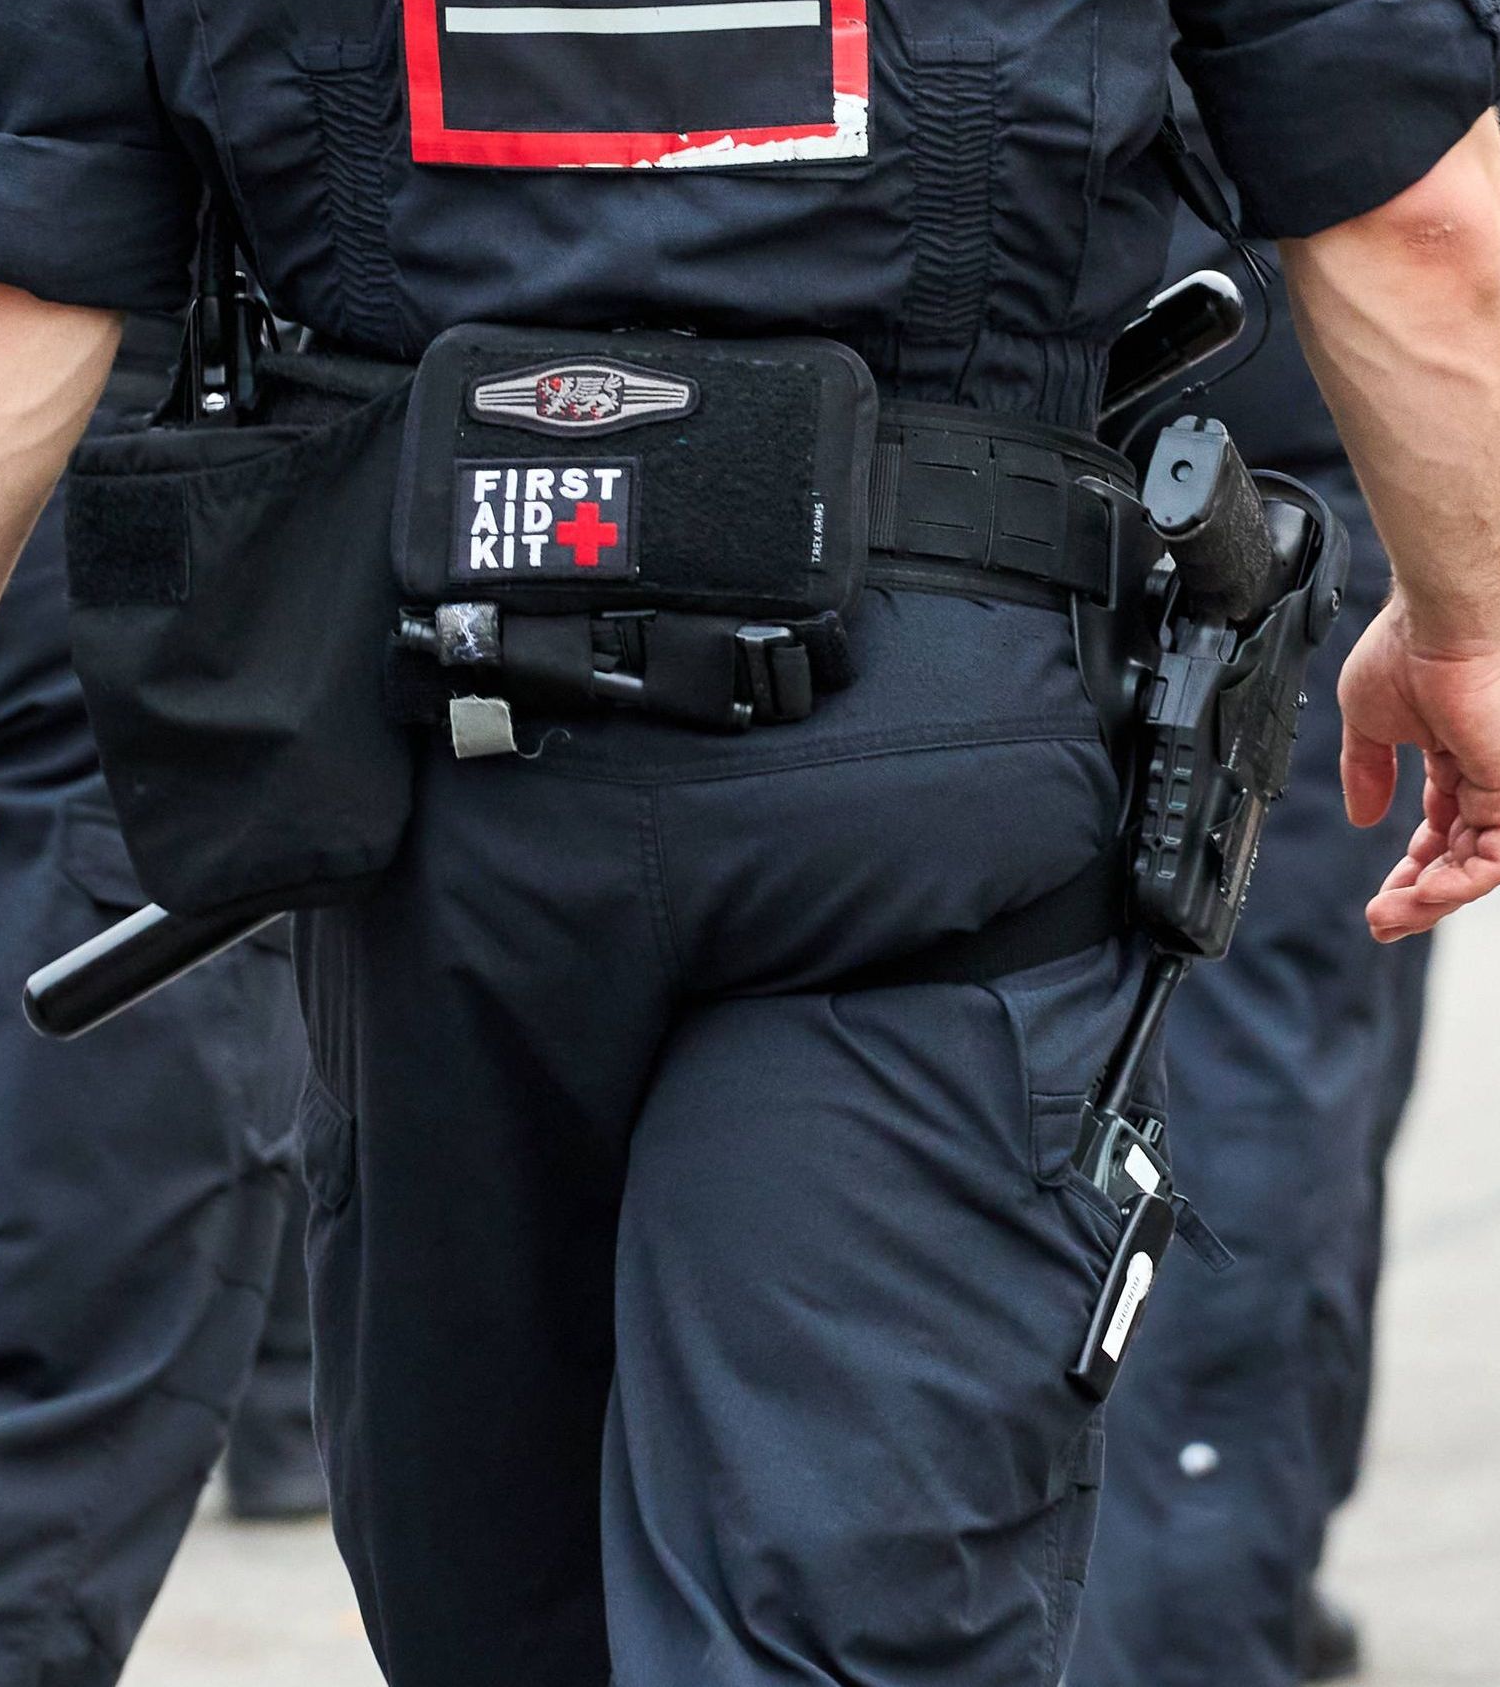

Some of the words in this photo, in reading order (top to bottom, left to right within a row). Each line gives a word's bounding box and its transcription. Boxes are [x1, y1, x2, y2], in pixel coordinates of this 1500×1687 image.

[473, 468, 622, 502] FIRST
[471, 501, 553, 535] AID
[470, 535, 549, 569] KIT
